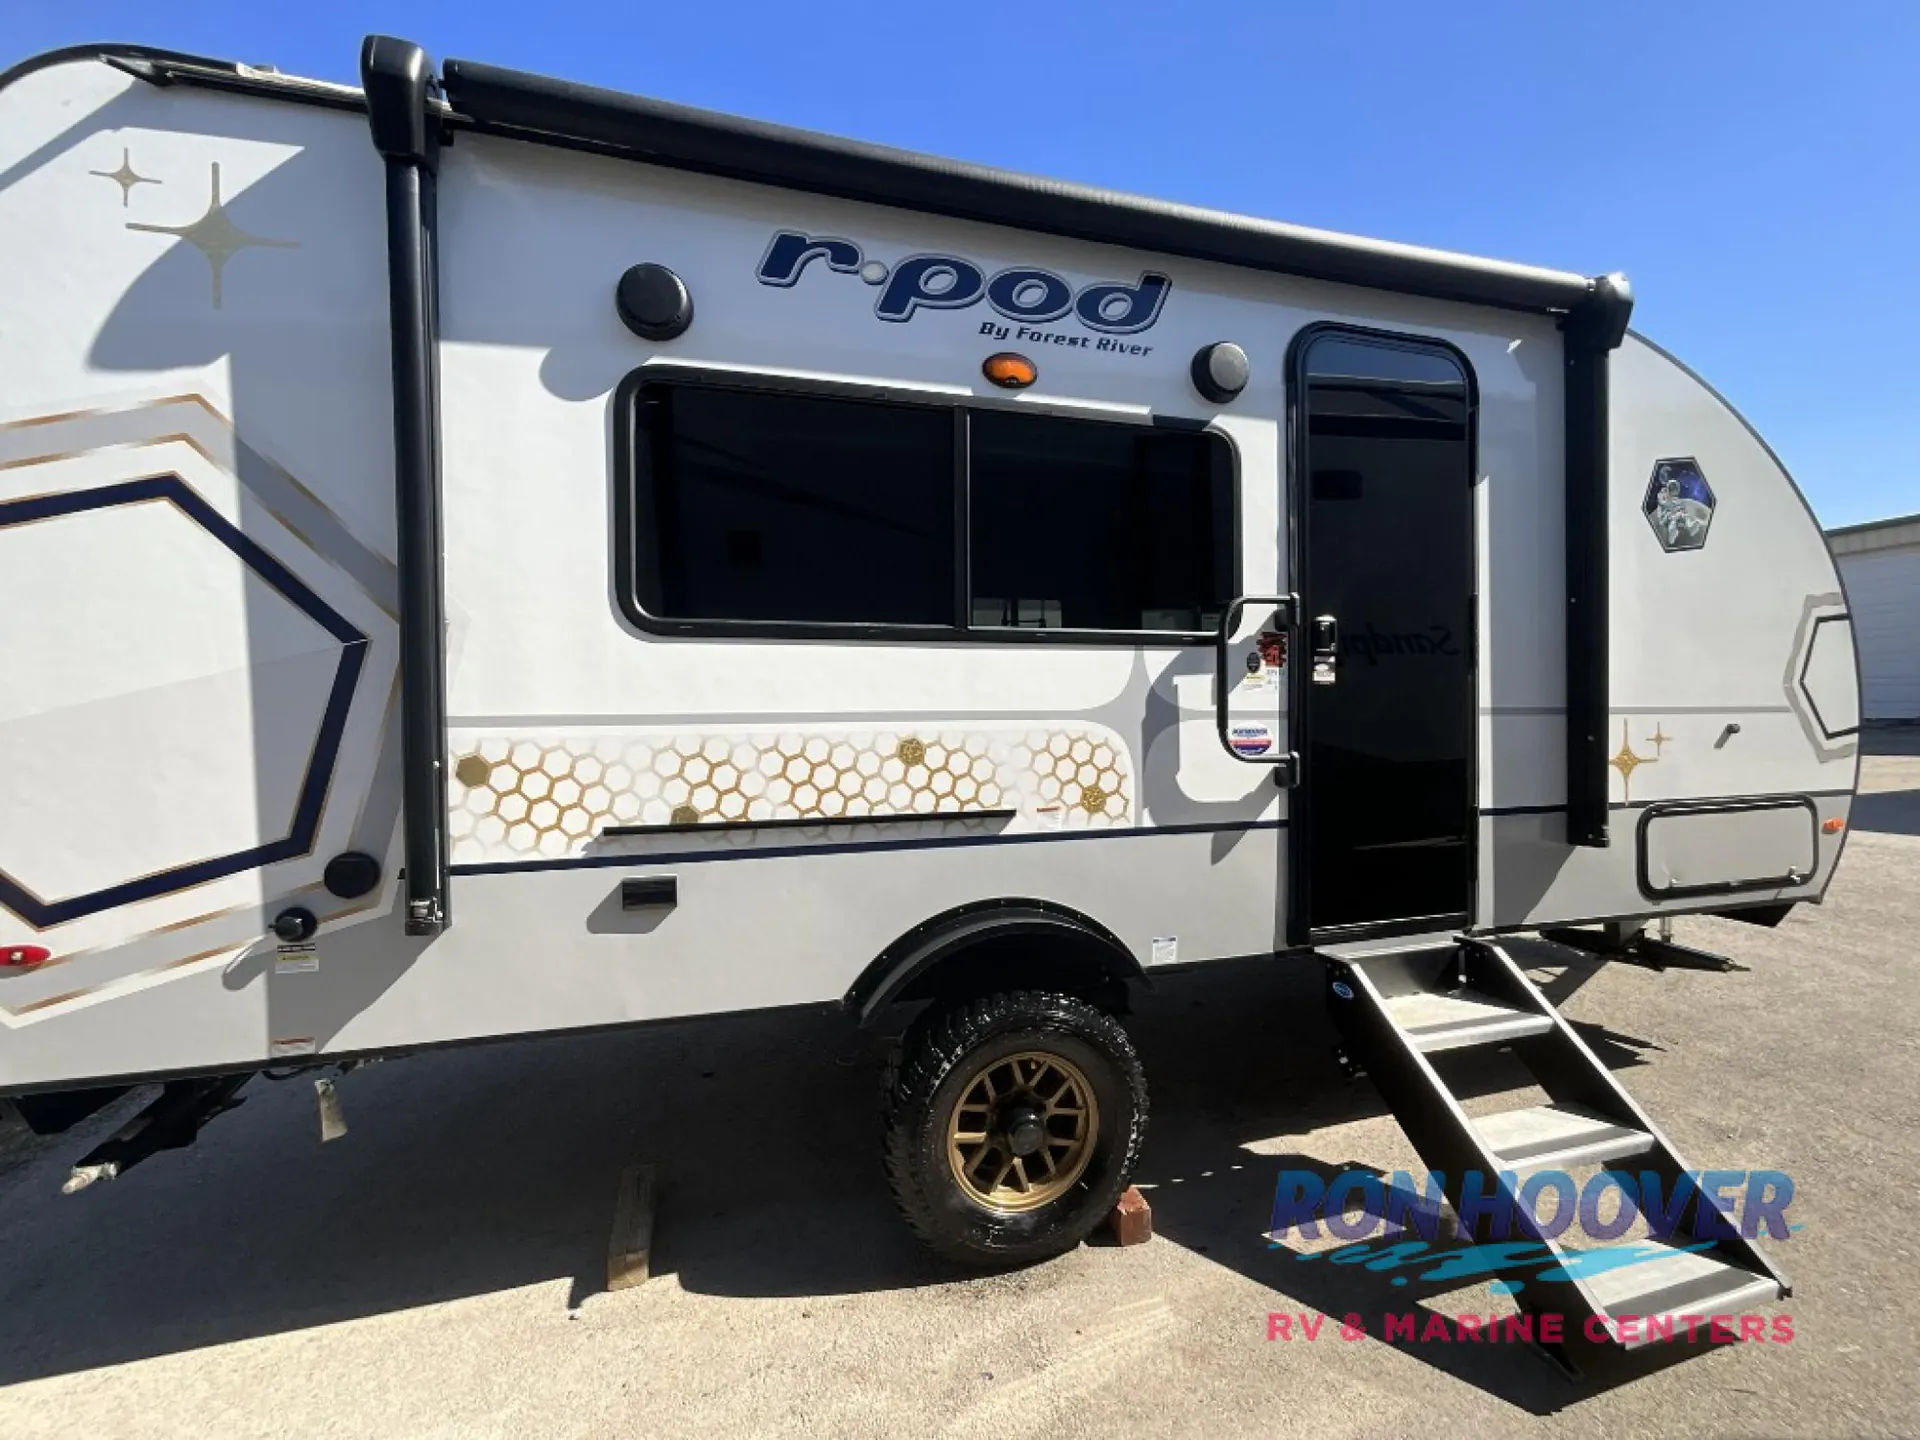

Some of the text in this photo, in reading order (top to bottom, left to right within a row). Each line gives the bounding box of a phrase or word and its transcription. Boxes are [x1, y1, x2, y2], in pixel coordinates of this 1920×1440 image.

[979, 321, 1154, 357] By Forest River
